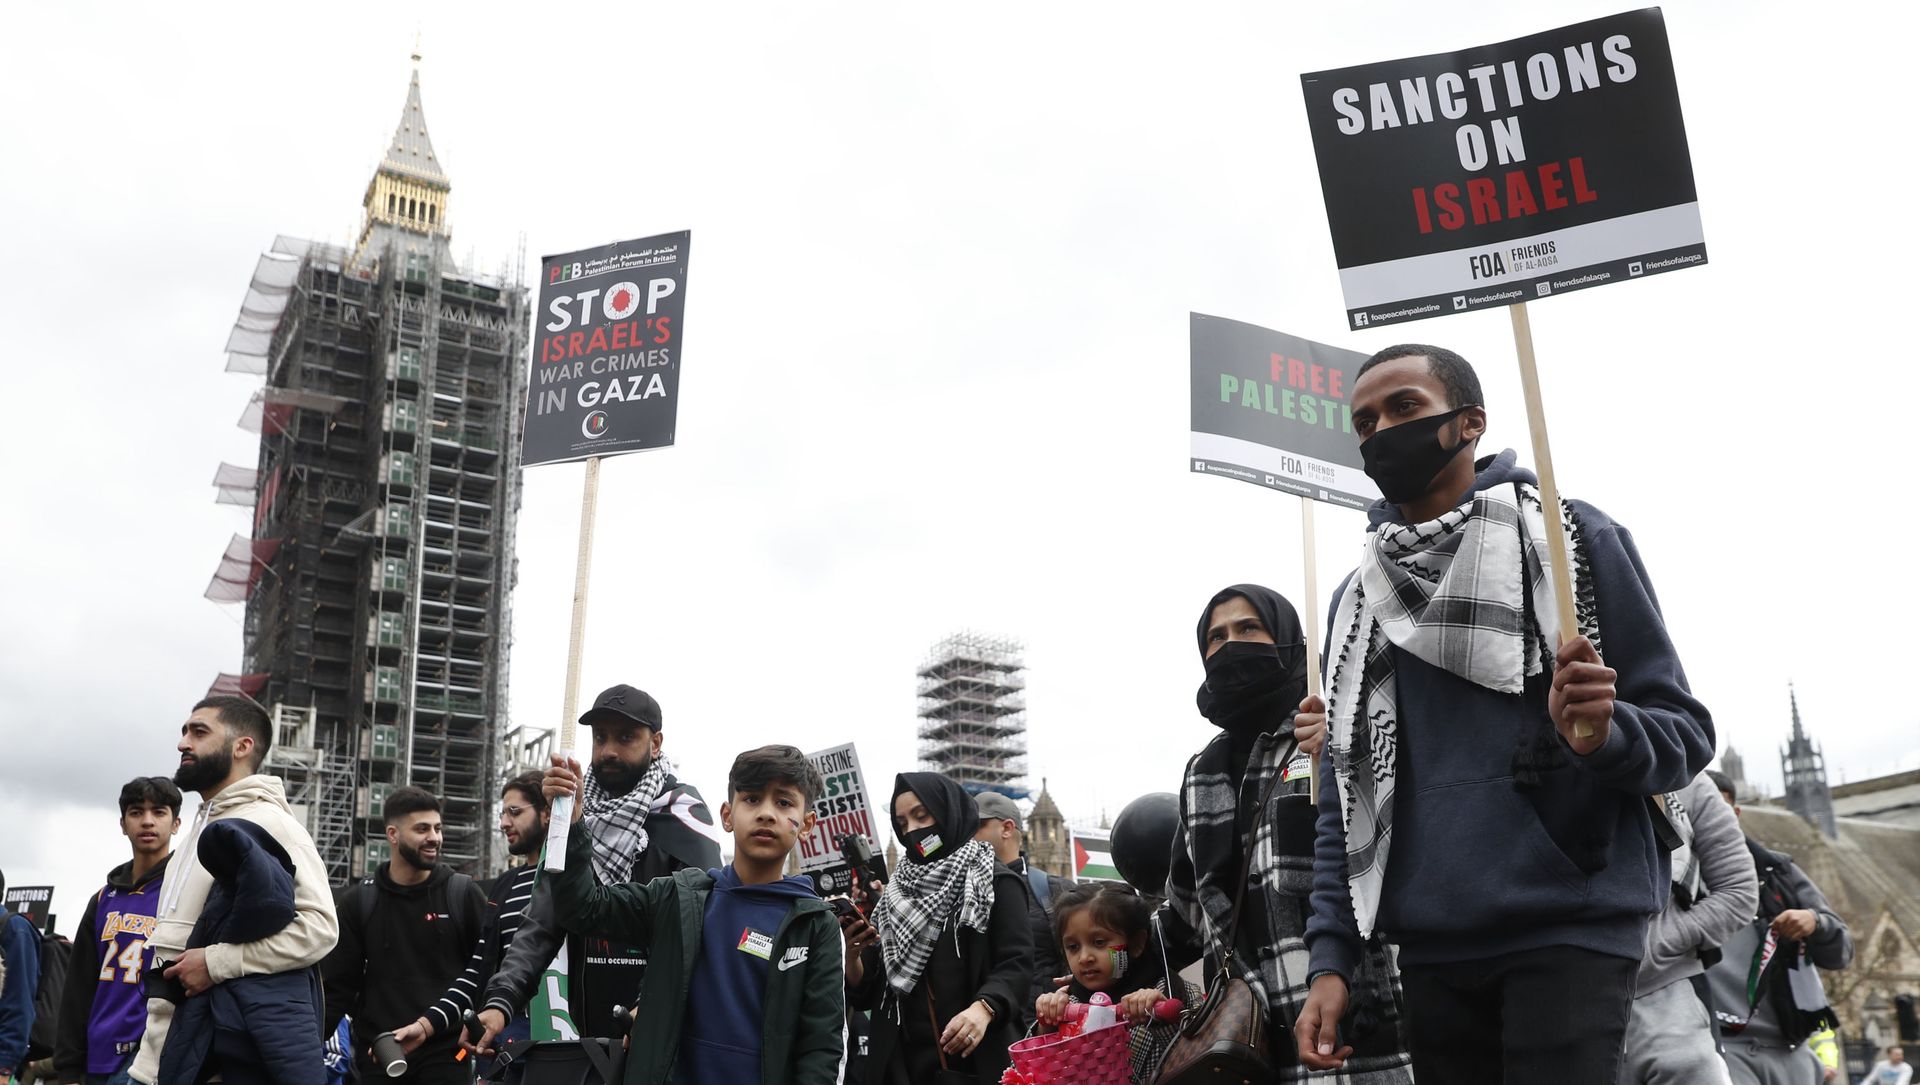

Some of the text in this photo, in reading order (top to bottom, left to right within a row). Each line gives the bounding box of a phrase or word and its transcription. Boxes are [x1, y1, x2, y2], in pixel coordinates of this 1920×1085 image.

[1332, 34, 1637, 136] SANCTIONS
[1455, 116, 1526, 172] ON
[1412, 157, 1598, 234] ISRAEL
[550, 262, 582, 283] PFB
[585, 262, 620, 276] Palestinian
[621, 259, 644, 268] Forum
[653, 254, 677, 263] Britain
[1469, 241, 1556, 280] FOA FRIENDS
[1514, 255, 1558, 272] OF AL-AQSA
[1646, 253, 1702, 270] friendsofalaqsa
[1553, 271, 1611, 289] friendsofalaqsa
[545, 277, 676, 332] STOP
[1468, 289, 1523, 305] friendsofalaqsa
[1371, 304, 1441, 321] foapeaceinpalestine
[541, 316, 672, 363] ISRAEL'S
[540, 348, 670, 385] WAR CRIMES
[1270, 352, 1344, 399] FREE
[537, 373, 667, 415] IN GAZA
[1220, 373, 1352, 434] PALESTI
[1281, 455, 1336, 478] FOA FRIENDS
[810, 749, 854, 776] LESTINE
[812, 792, 864, 818] SIST!
[7, 889, 49, 902] SANCTIONS
[99, 939, 143, 984] 24
[784, 947, 809, 961] NIKE
